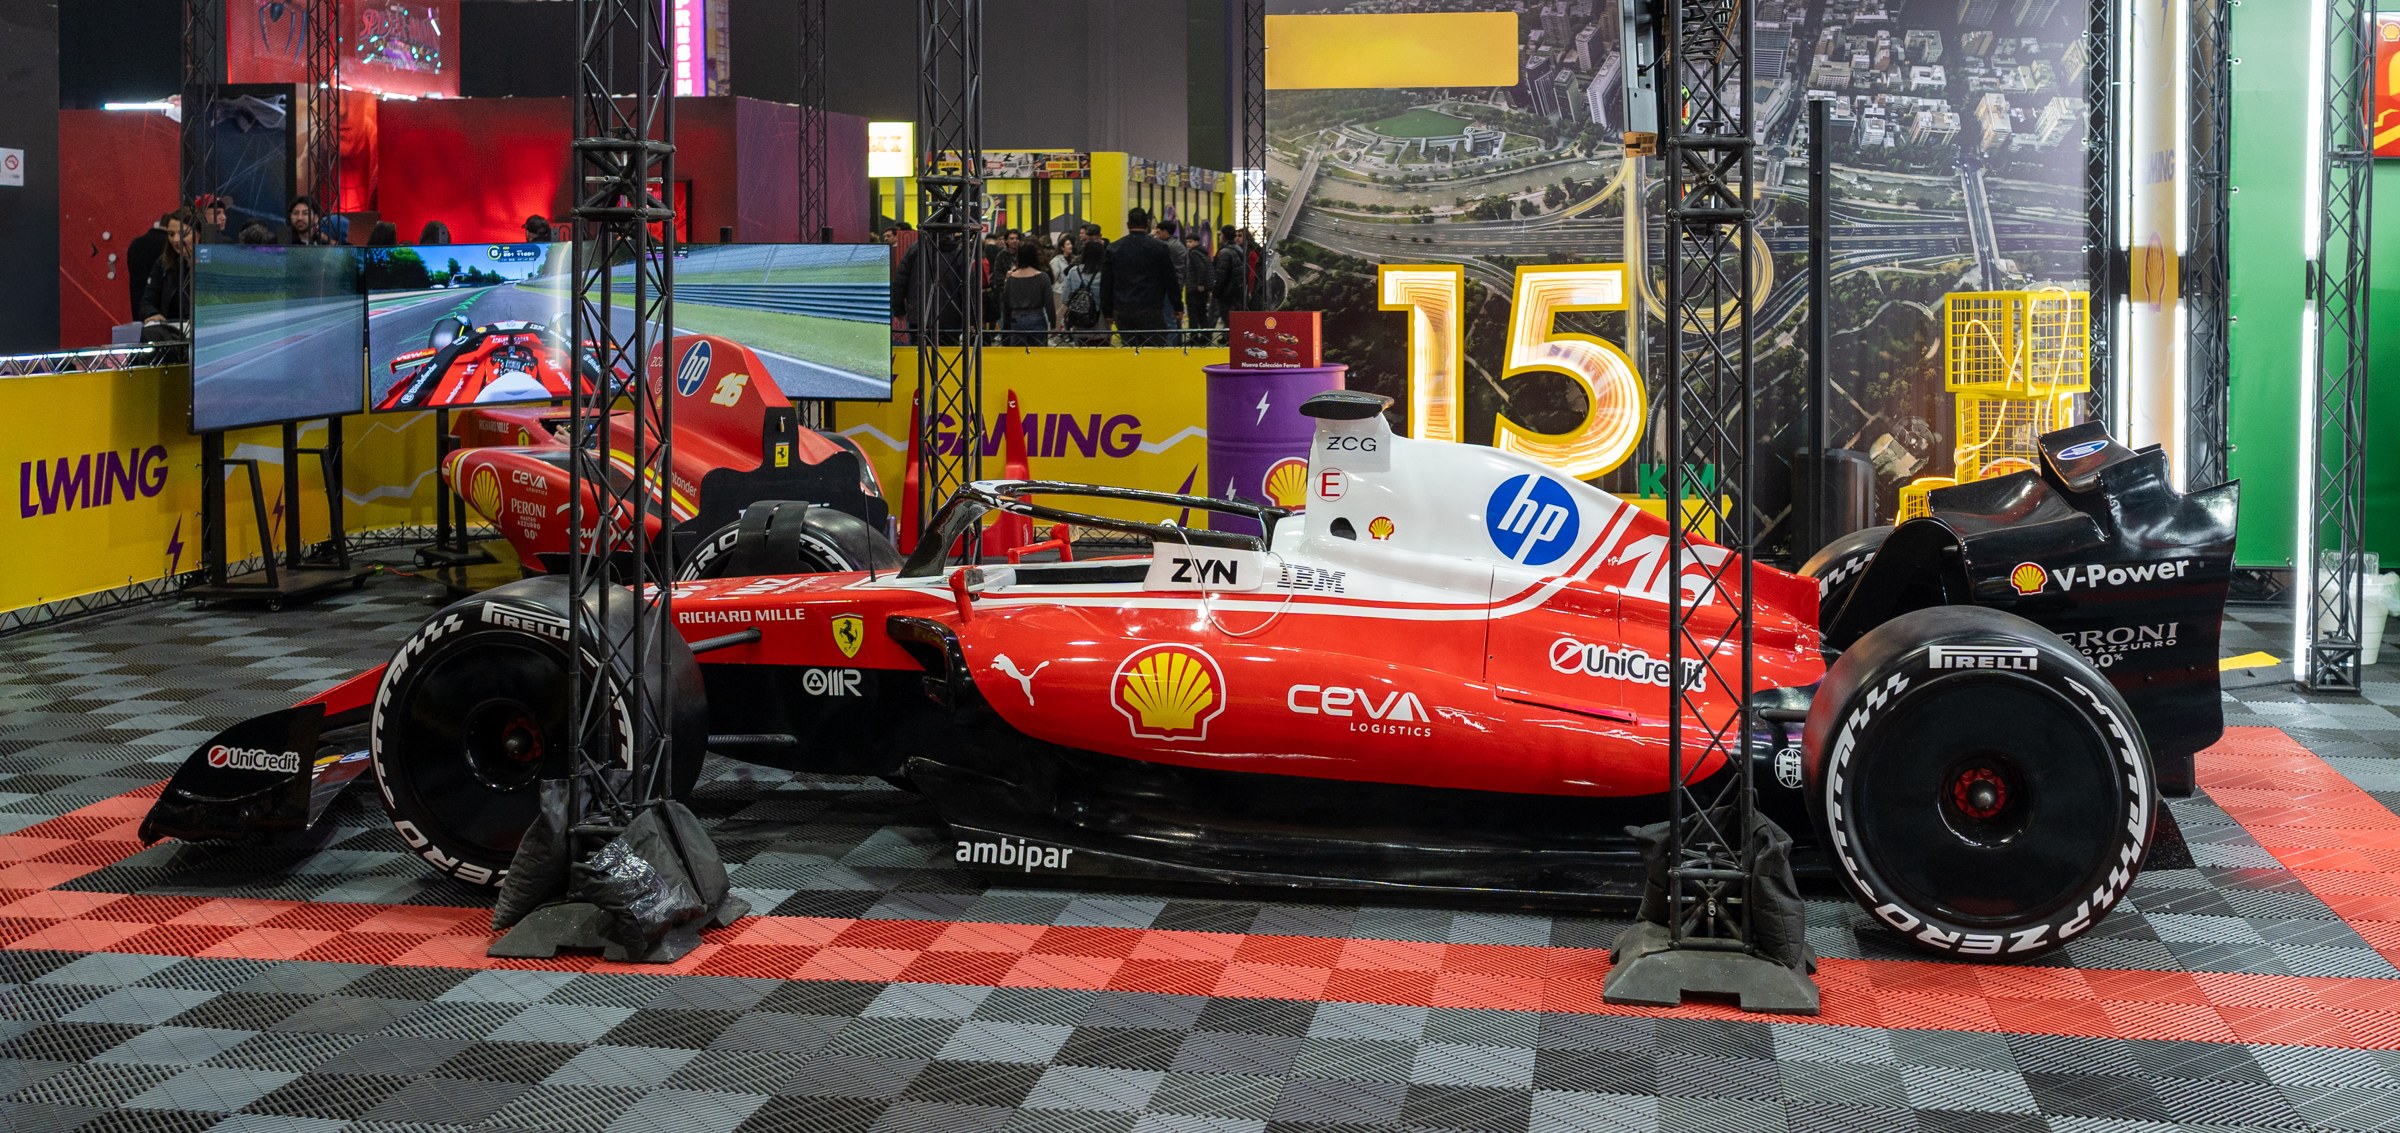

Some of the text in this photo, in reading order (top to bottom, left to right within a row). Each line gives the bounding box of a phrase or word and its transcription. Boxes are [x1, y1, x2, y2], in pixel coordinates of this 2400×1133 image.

[678, 340, 711, 397] hp
[1378, 263, 1647, 481] 15
[710, 372, 749, 408] 16
[1326, 436, 1377, 452] ZCG
[671, 471, 697, 498] ntander
[1321, 472, 1341, 497] E
[1639, 464, 1715, 499] KM
[511, 498, 546, 518] PERONI
[1494, 474, 1571, 565] hp
[1170, 557, 1238, 585] ZYN
[1276, 562, 1346, 594] IBM
[1603, 534, 1730, 607] 16
[2052, 559, 2189, 592] V-Power
[481, 601, 571, 642] PIRELLI
[679, 608, 806, 624] RICHARD MILLE
[2056, 622, 2179, 649] ERONI
[2096, 638, 2178, 655] AZZURRO
[1586, 647, 1703, 689] UniCreit
[1928, 645, 2039, 671] PIRELLI
[1350, 722, 1431, 737] LOGISTICS
[229, 748, 299, 772] UniCredit
[955, 837, 1073, 873] ambipar
